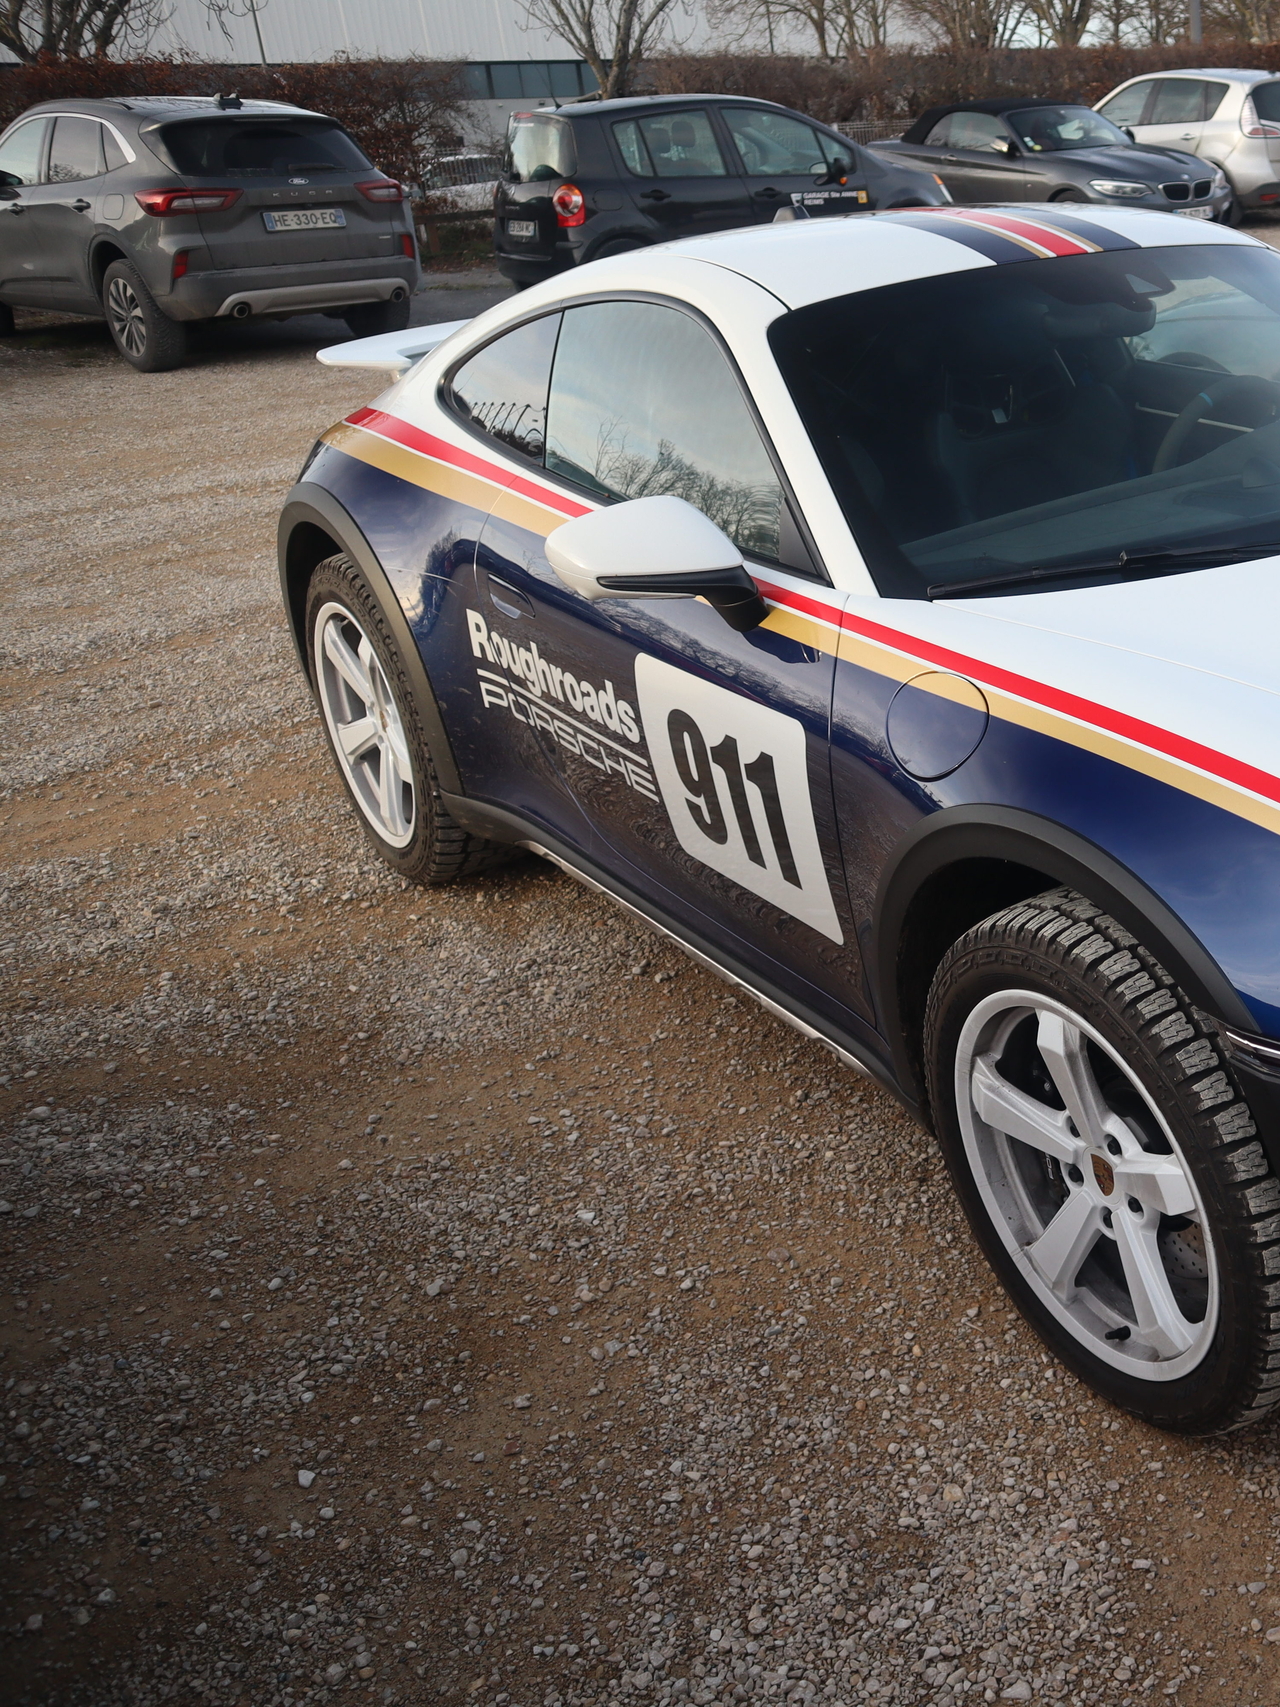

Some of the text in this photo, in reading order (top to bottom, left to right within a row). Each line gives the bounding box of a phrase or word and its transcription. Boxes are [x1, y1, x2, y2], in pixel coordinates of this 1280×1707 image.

[466, 609, 641, 743] Roughroads
[479, 681, 660, 803] PORSCHE
[667, 708, 804, 891] 911
